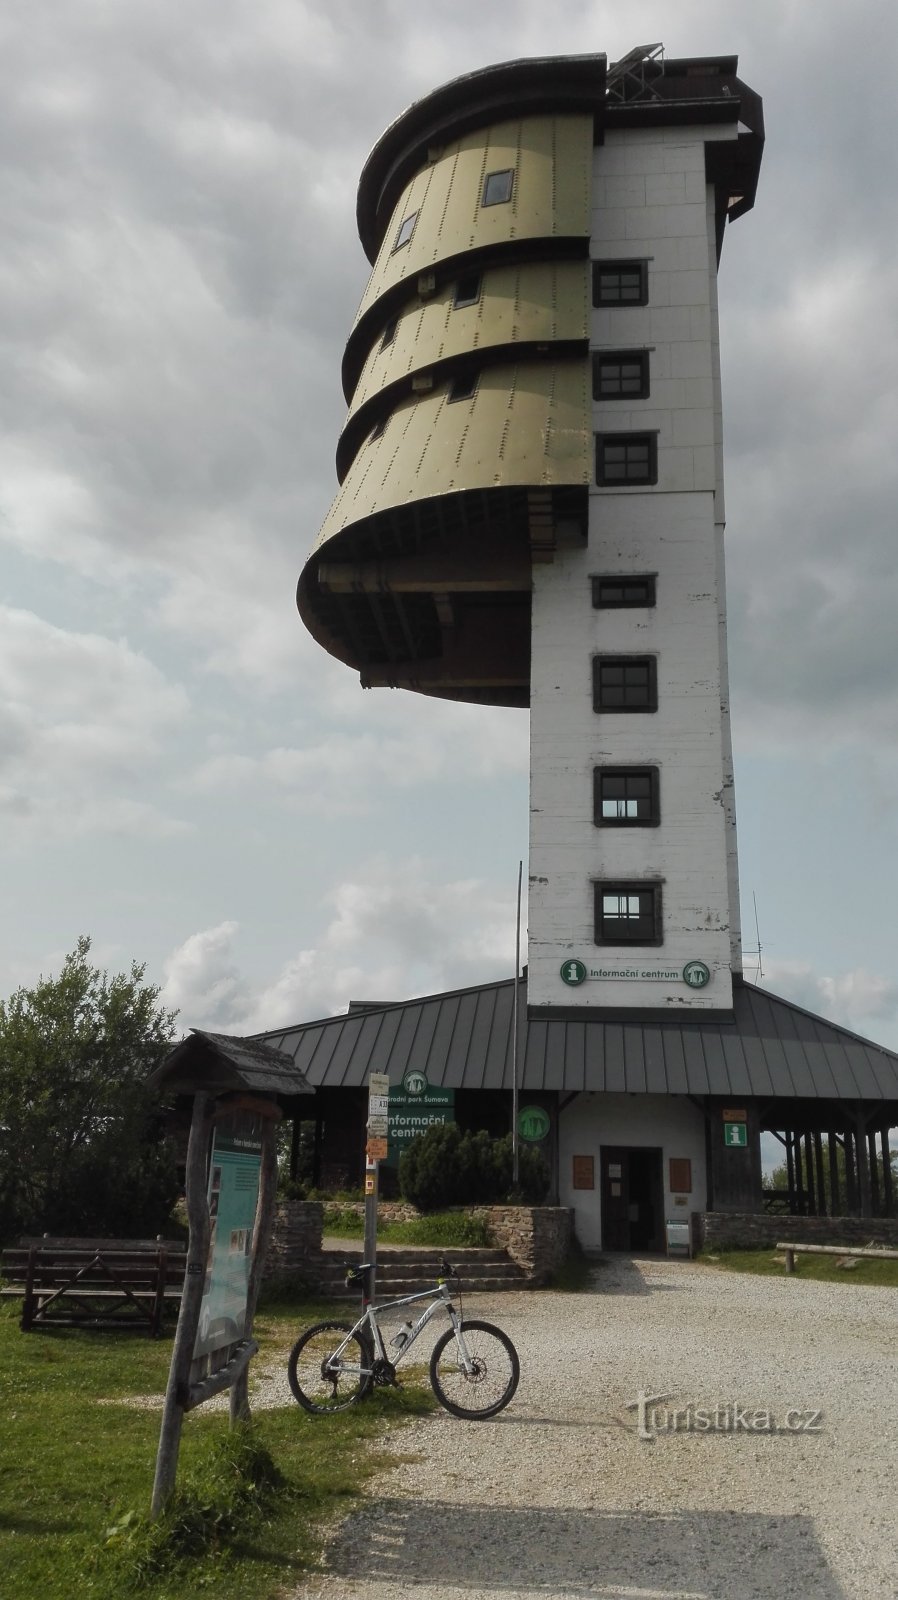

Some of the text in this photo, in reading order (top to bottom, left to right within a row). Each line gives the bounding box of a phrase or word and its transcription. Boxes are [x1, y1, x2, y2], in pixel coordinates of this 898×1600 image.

[590, 969, 679, 979] Informační centrum
[388, 1115, 445, 1126] nformační
[391, 1128, 427, 1137] centru
